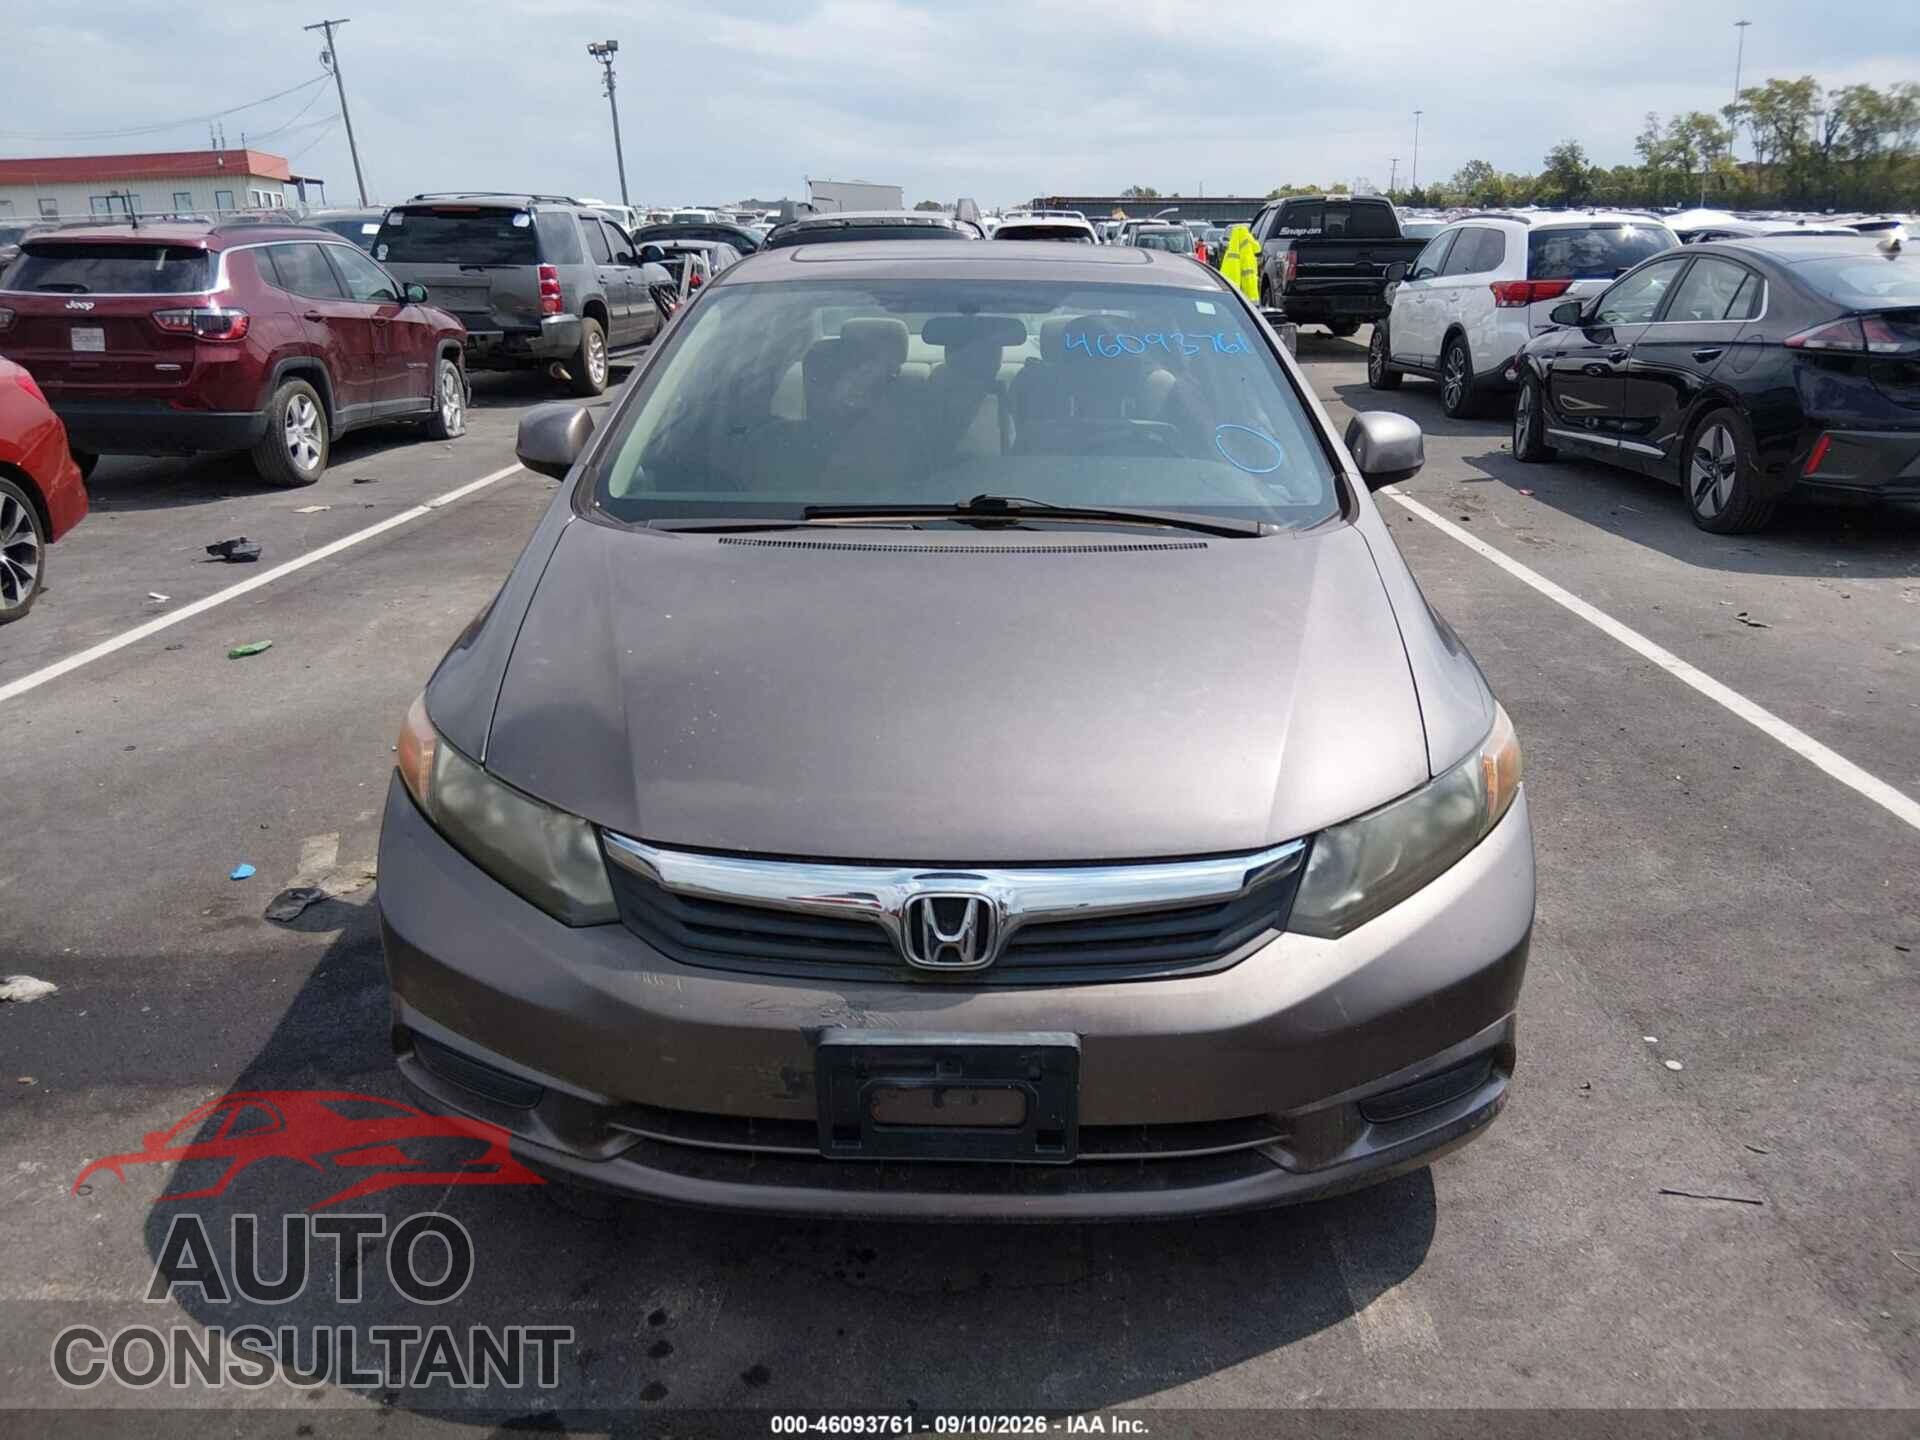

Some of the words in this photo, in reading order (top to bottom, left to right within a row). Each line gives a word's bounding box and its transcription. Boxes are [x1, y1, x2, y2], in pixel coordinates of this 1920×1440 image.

[1279, 227, 1322, 237] Snap-on
[65, 300, 95, 311] Jeep
[1065, 331, 1249, 358] 46093761
